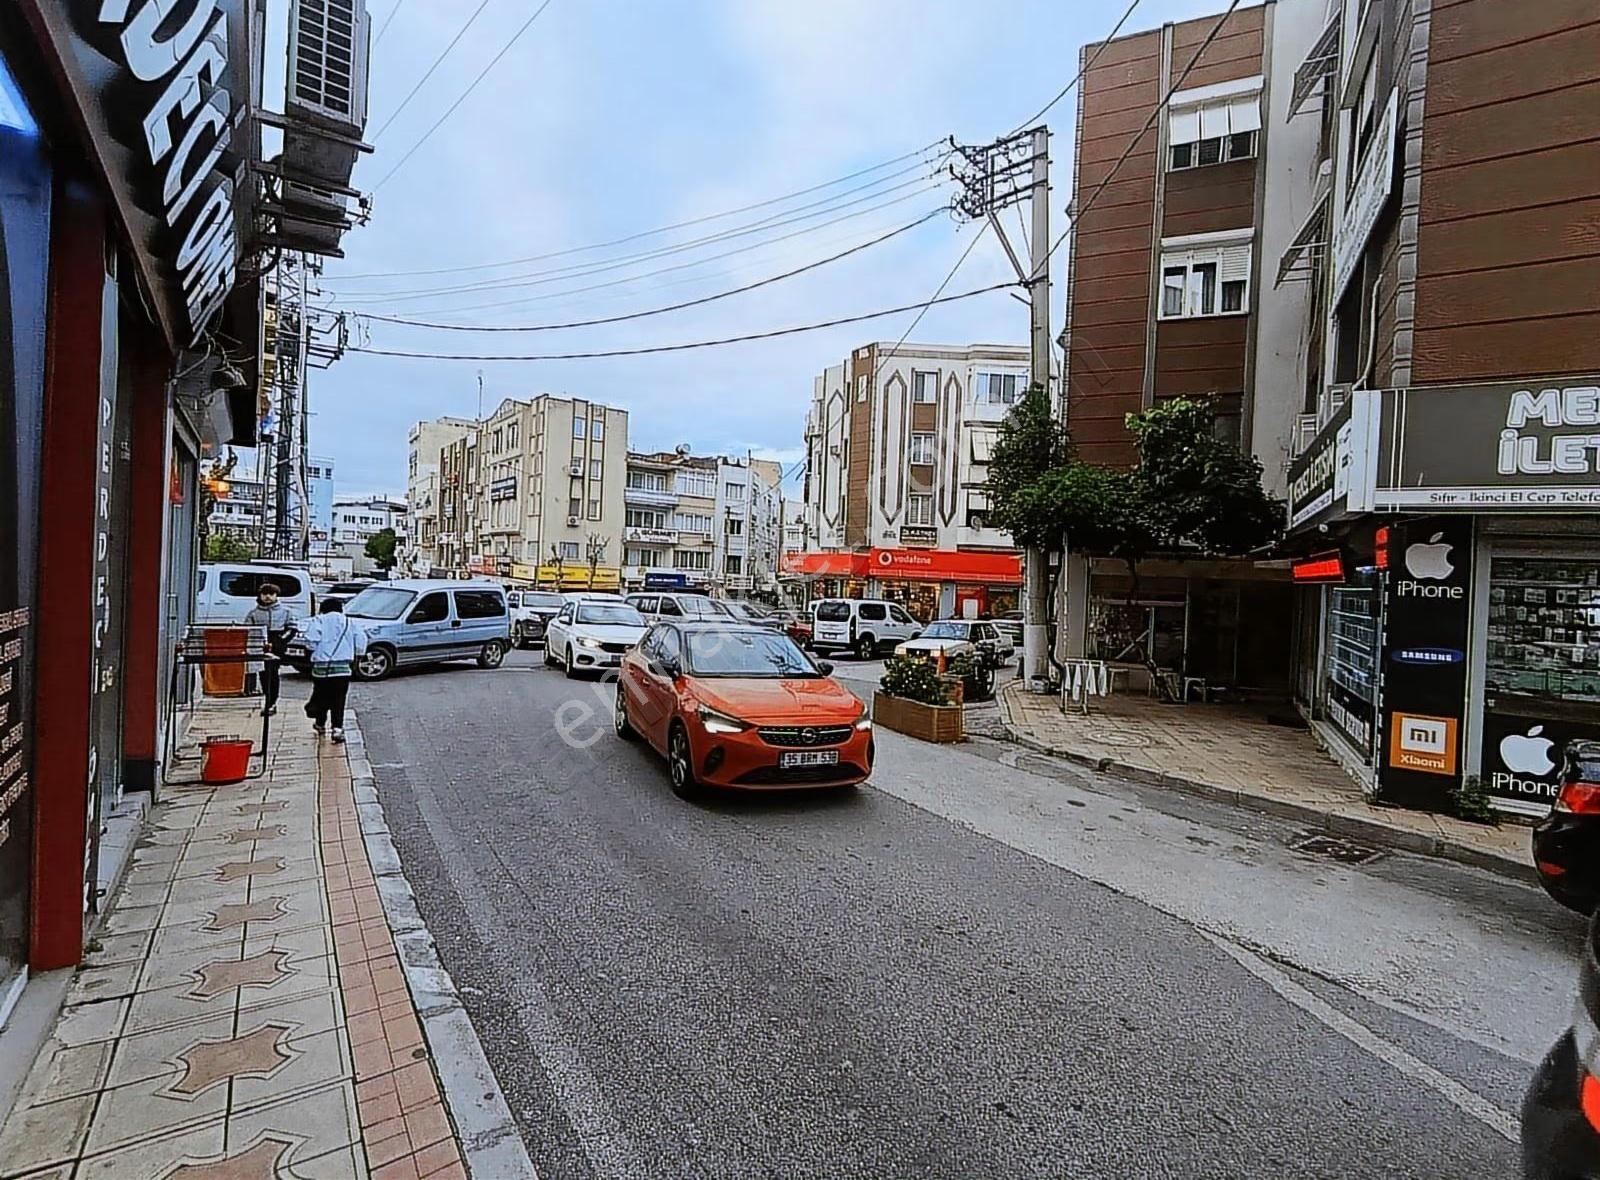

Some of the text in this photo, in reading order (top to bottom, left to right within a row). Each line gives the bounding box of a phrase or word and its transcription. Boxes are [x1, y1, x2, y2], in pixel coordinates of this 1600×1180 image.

[98, 0, 246, 228] DECİ
[1506, 387, 1600, 428] ME
[1511, 491, 1523, 502] El
[1527, 491, 1556, 504] Cep
[93, 397, 112, 695] PERDECİ
[893, 553, 932, 565] vodafone
[1398, 580, 1464, 600] iPhone
[1401, 650, 1453, 662] SAMSUNG
[1492, 772, 1559, 797] iPhone
